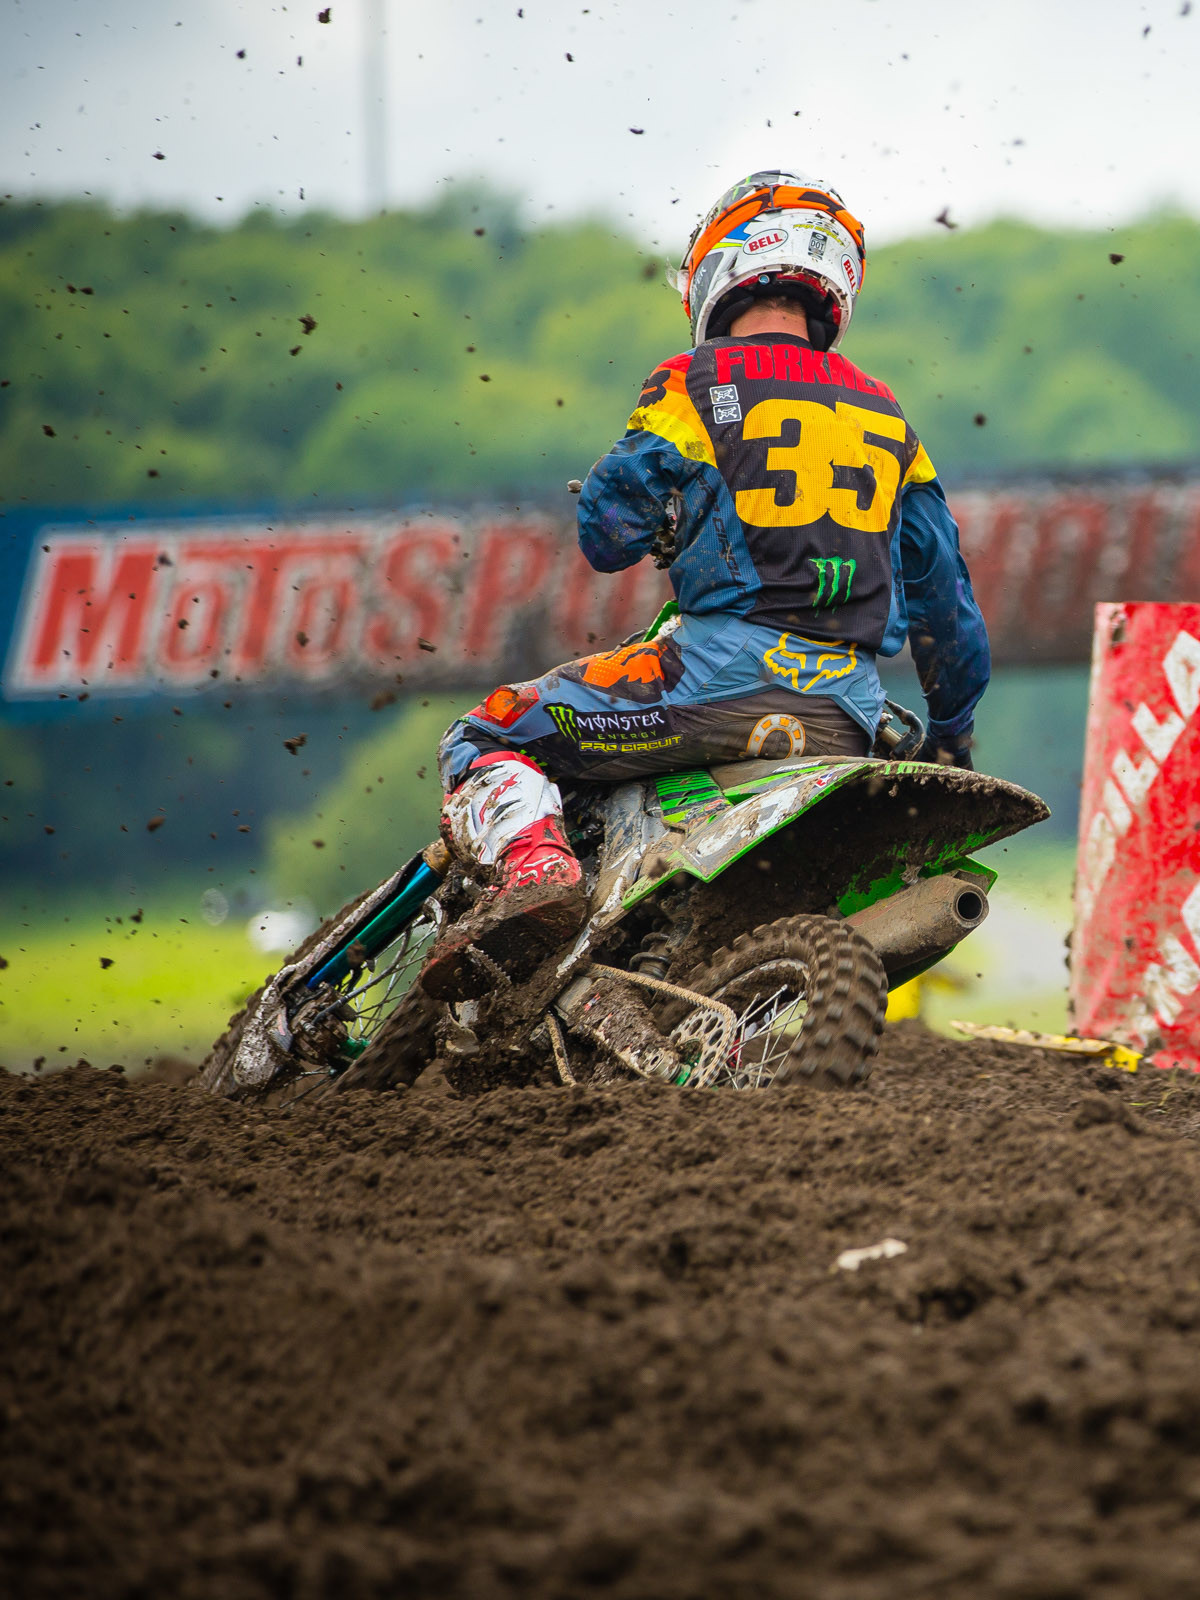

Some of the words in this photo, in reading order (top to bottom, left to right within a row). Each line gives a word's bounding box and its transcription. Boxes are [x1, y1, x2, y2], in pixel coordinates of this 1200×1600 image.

[748, 233, 784, 252] BELL
[843, 259, 857, 292] BELL
[736, 399, 906, 533] 35
[18, 516, 676, 684] MOTOSPO
[576, 711, 665, 732] MONSTER
[580, 742, 618, 752] PRO
[620, 736, 682, 752] CIRCUIT
[597, 730, 657, 740] ENERGY
